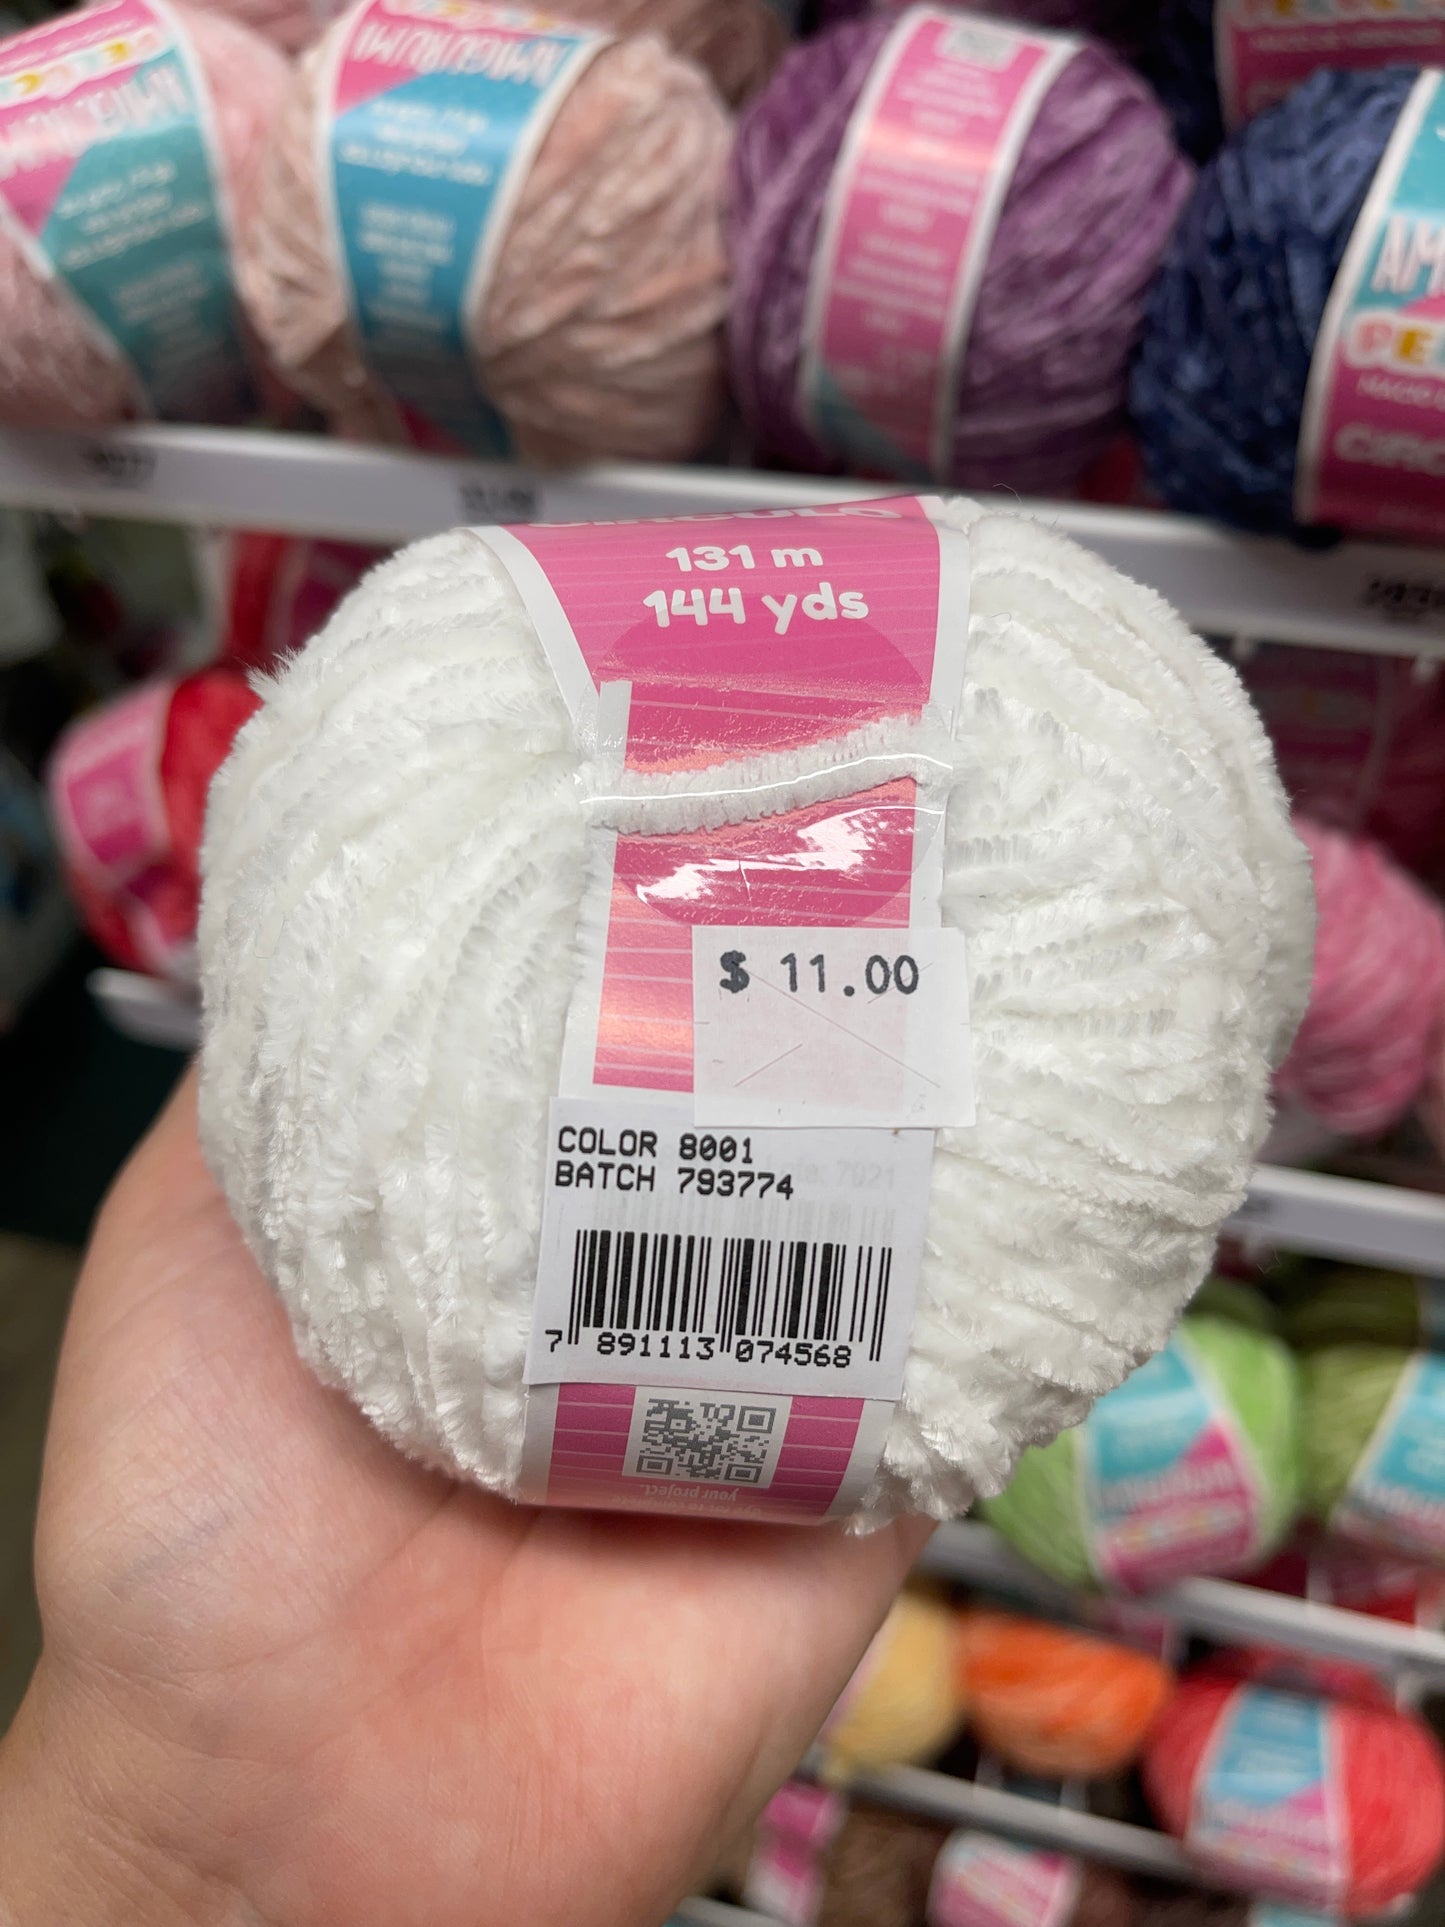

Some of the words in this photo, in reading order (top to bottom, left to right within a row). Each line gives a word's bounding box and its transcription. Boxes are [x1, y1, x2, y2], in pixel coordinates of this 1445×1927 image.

[666, 545, 756, 571] 131
[771, 547, 824, 568] m
[642, 587, 746, 627] 144
[761, 582, 869, 635] yds
[719, 950, 750, 994] $
[780, 953, 919, 997] 11.00
[558, 1126, 658, 1157] COLOR
[679, 1133, 753, 1164] 8001
[554, 1160, 656, 1191] BATCH
[677, 1167, 794, 1200] 793774
[544, 1329, 562, 1353] 7
[596, 1331, 716, 1361] 891113
[734, 1338, 852, 1368] 074568
[702, 1487, 740, 1502] your
